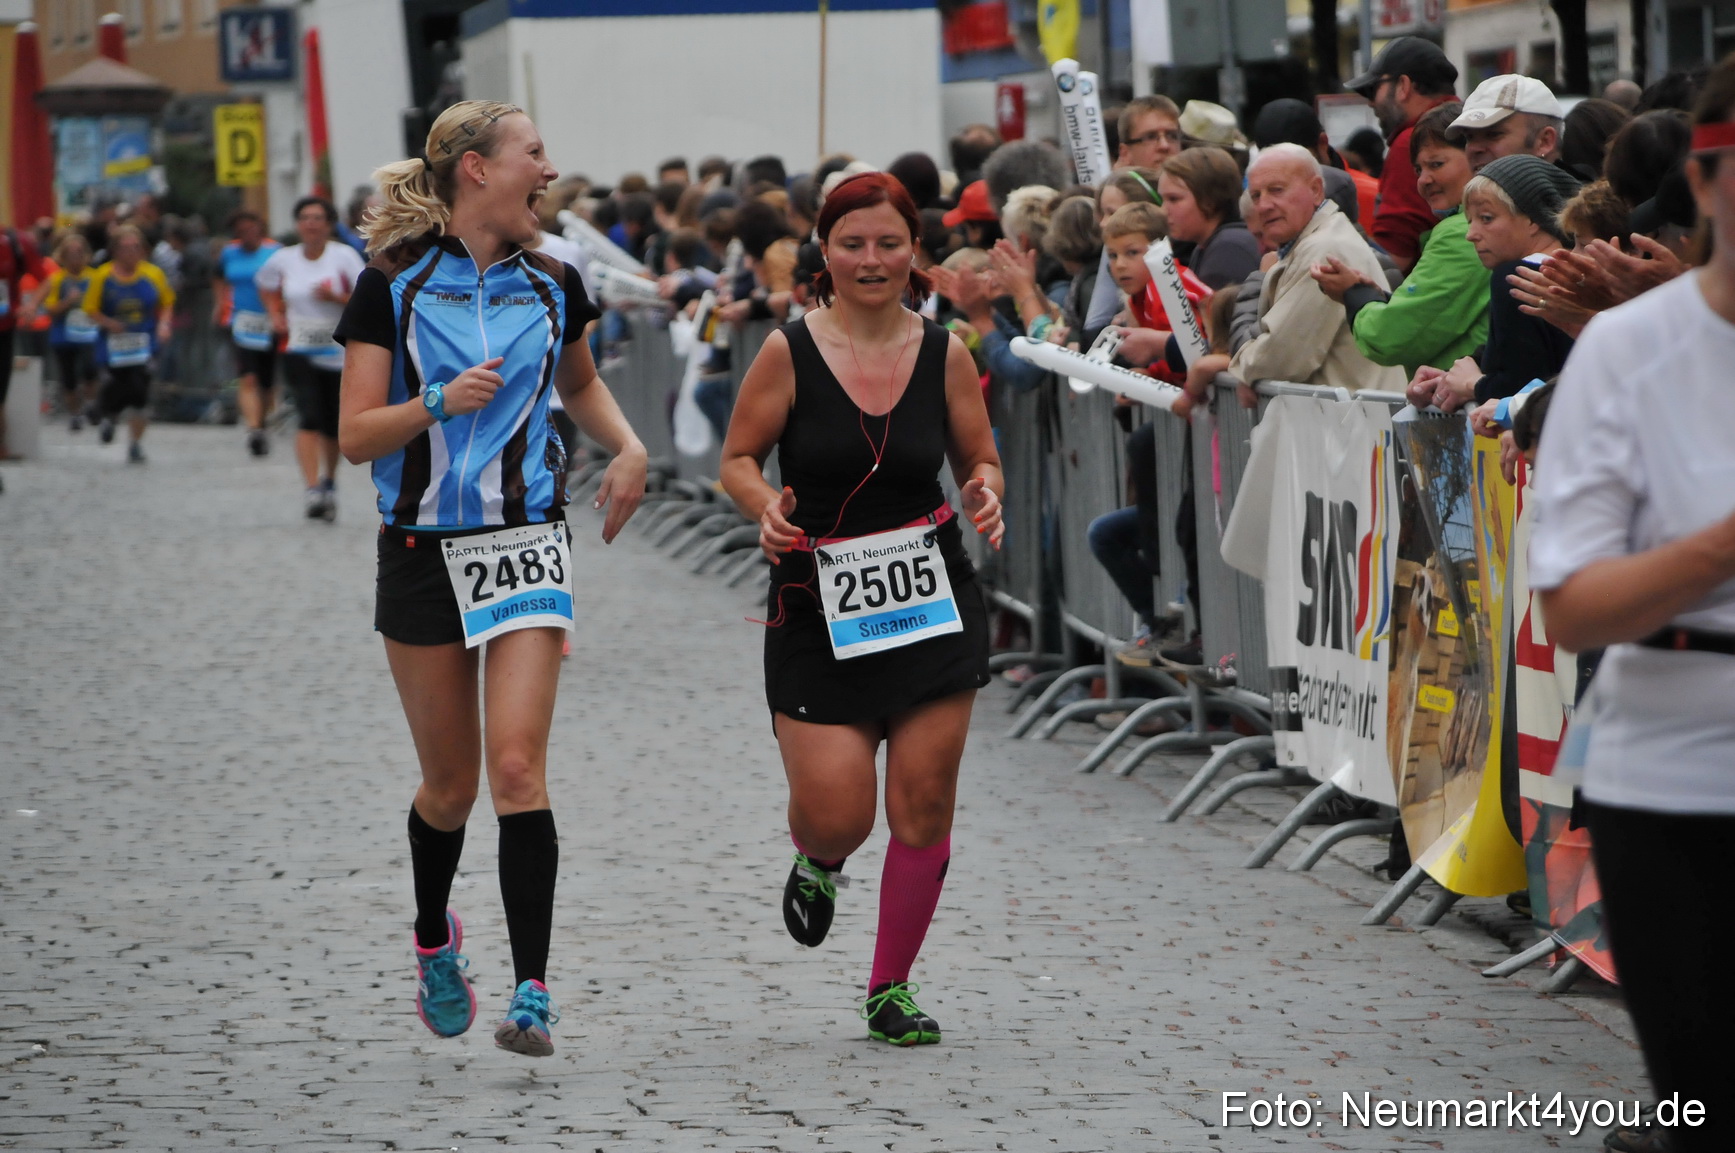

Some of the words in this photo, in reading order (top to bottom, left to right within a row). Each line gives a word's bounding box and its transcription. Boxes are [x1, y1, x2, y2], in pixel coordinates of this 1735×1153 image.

[229, 128, 257, 167] D
[447, 546, 490, 561] PARTL
[491, 534, 550, 554] Neumarkt
[863, 540, 920, 560] Neumarkt
[464, 545, 565, 604] 2483
[834, 555, 937, 614] 2505
[490, 596, 557, 623] Vanessa
[858, 612, 928, 638] Susanne
